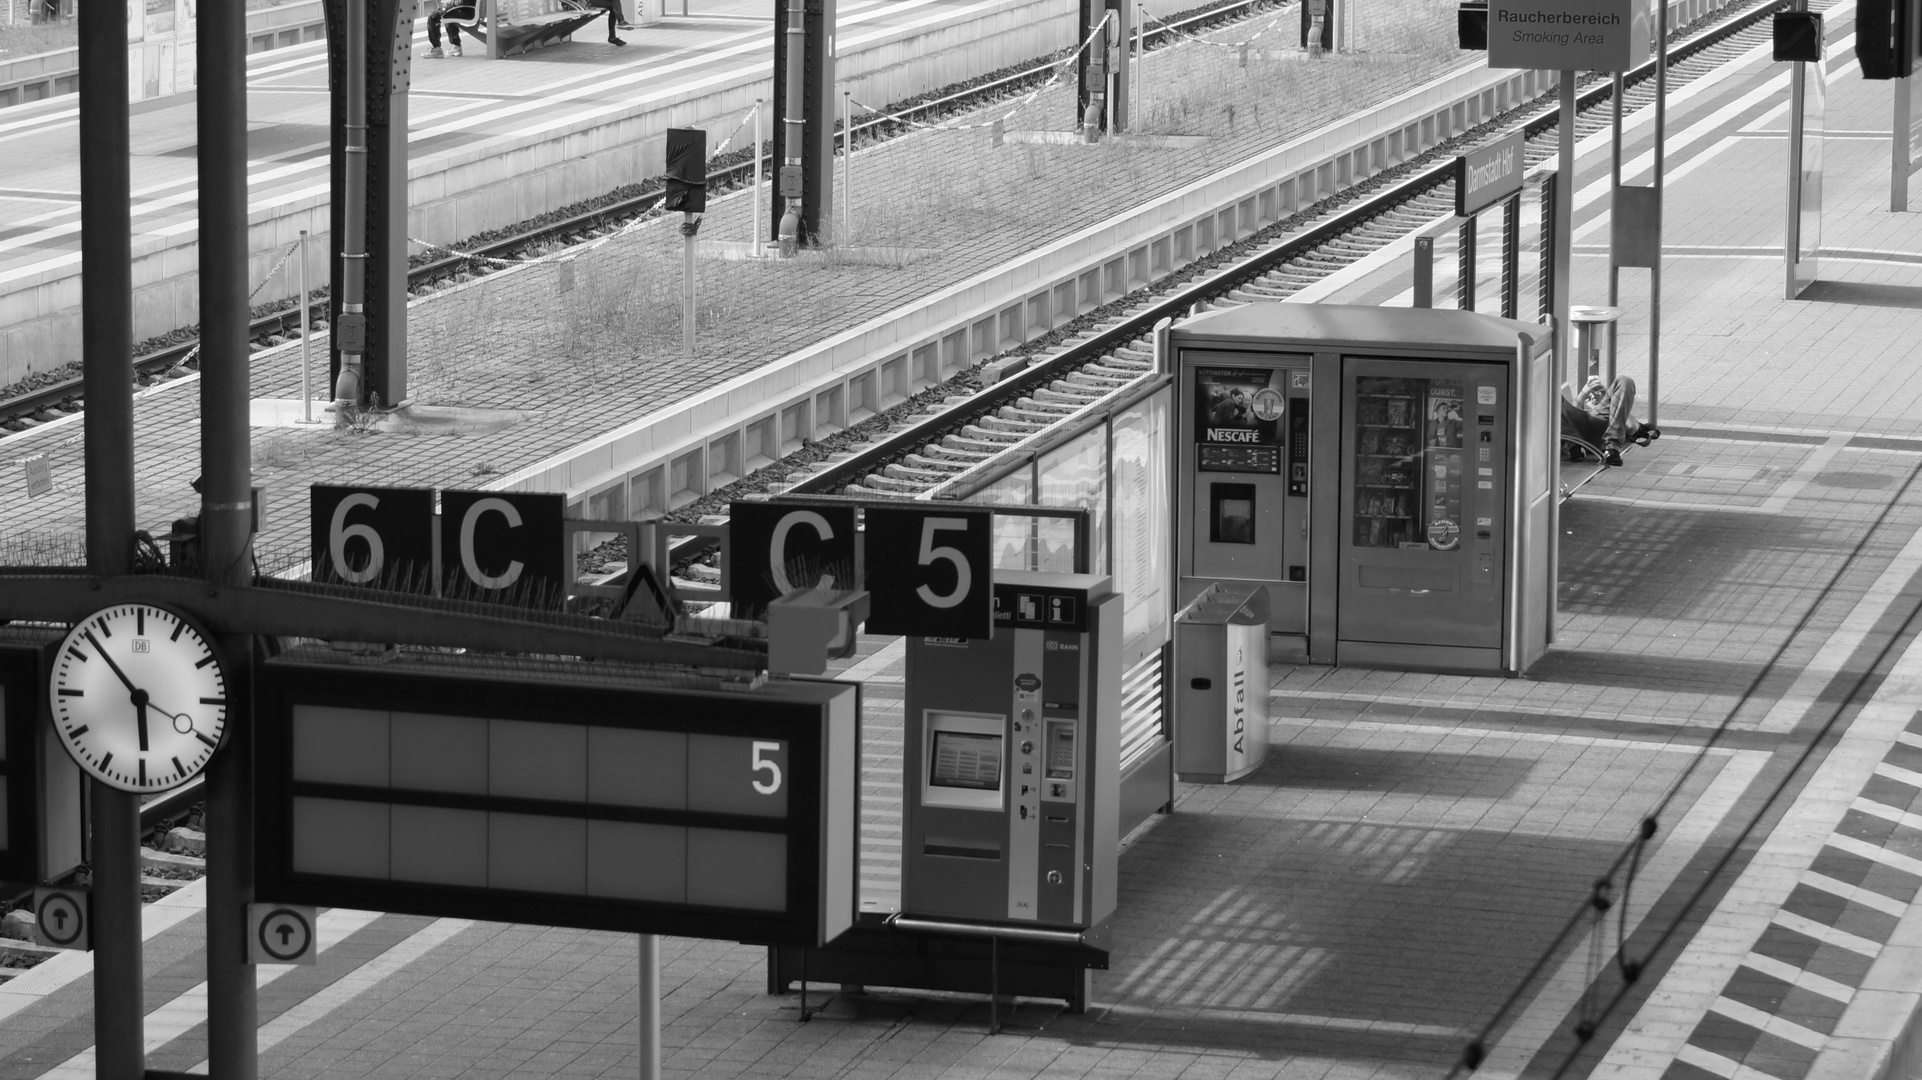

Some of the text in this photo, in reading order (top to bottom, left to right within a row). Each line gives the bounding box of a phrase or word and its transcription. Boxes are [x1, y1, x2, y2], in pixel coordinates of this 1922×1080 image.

[1498, 9, 1620, 25] Raucherbereich
[1512, 29, 1605, 46] Smoking Area
[1468, 145, 1514, 194] Darmstadt Hbf
[1430, 388, 1457, 397] DURST.
[1207, 428, 1259, 443] NESCAFÉ
[330, 493, 524, 589] 6 C
[770, 510, 972, 608] C 5
[134, 640, 148, 651] DB
[1059, 643, 1079, 651] BAHN
[1233, 670, 1245, 755] Abfall
[752, 740, 782, 795] 5
